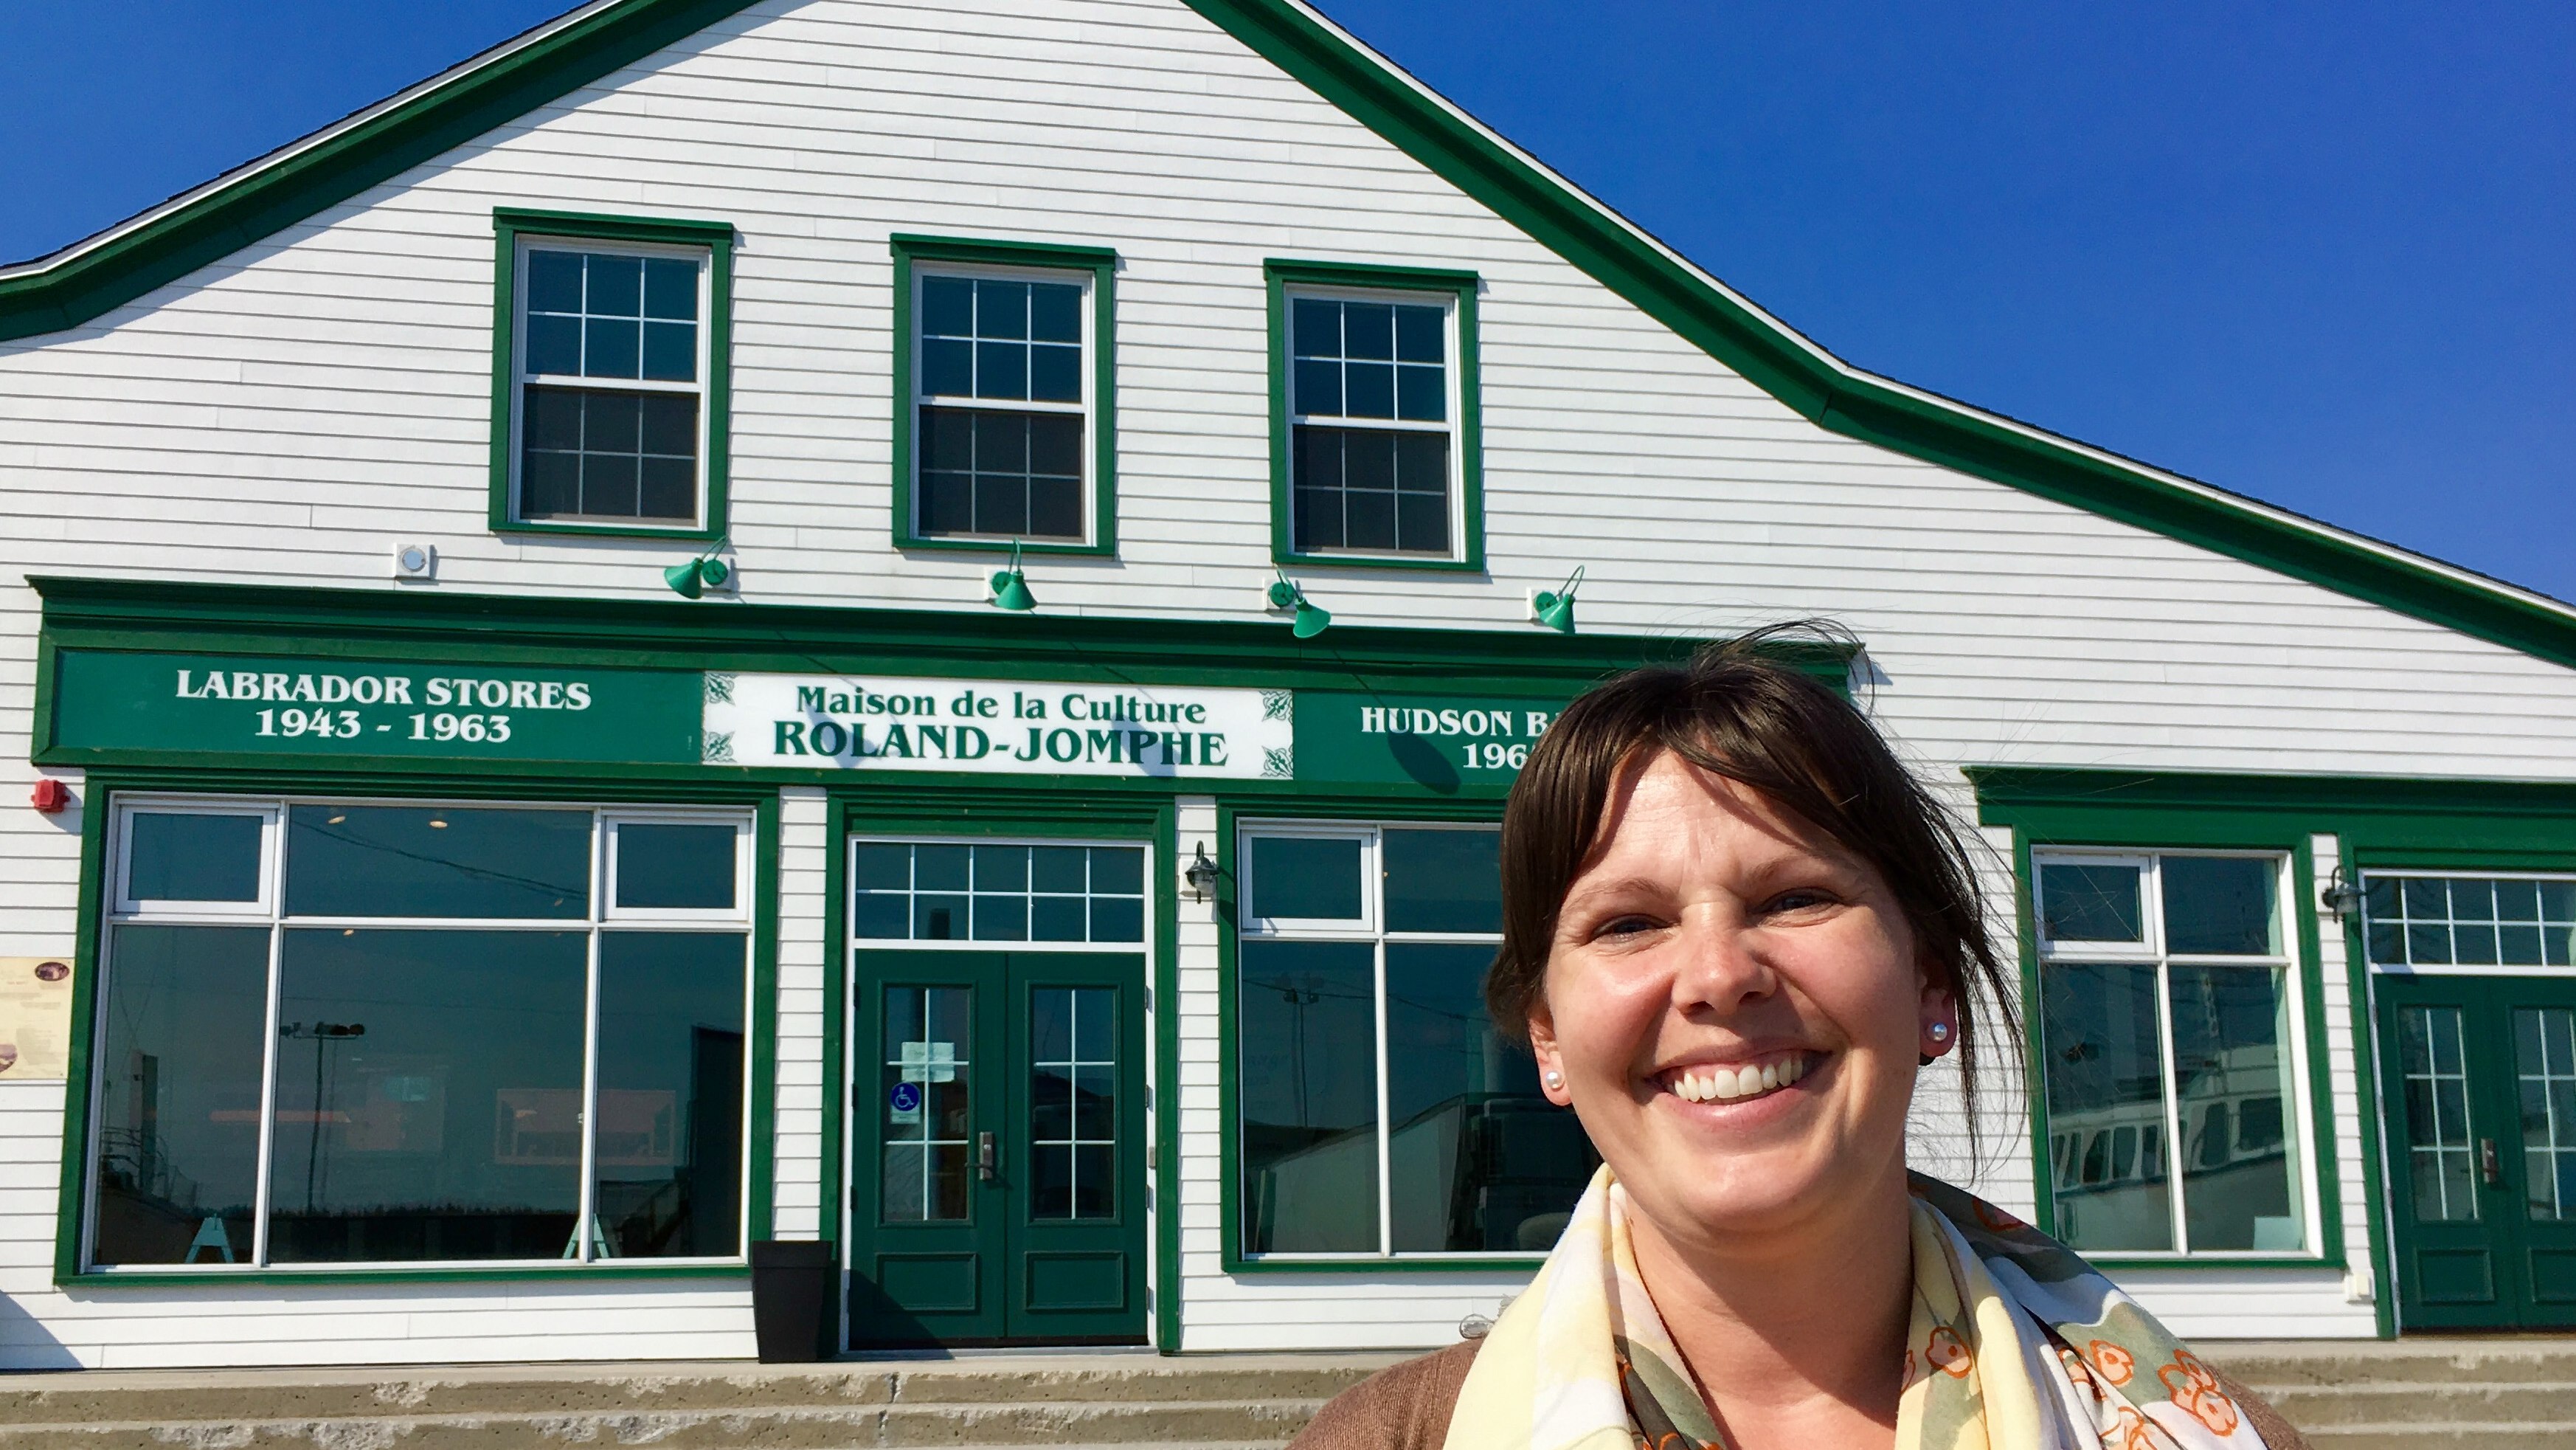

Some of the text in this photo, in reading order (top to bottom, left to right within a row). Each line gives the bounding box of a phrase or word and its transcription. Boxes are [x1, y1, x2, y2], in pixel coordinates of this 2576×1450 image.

[176, 669, 592, 711] LABRADOR STORES
[797, 685, 1206, 724] Maison de la Culture
[255, 708, 361, 738] 1943
[408, 713, 511, 743] 1963
[1361, 707, 1559, 737] HUDSON B
[774, 721, 1228, 767] ROLAND-JOMPHE
[1462, 743, 1536, 770] 196
